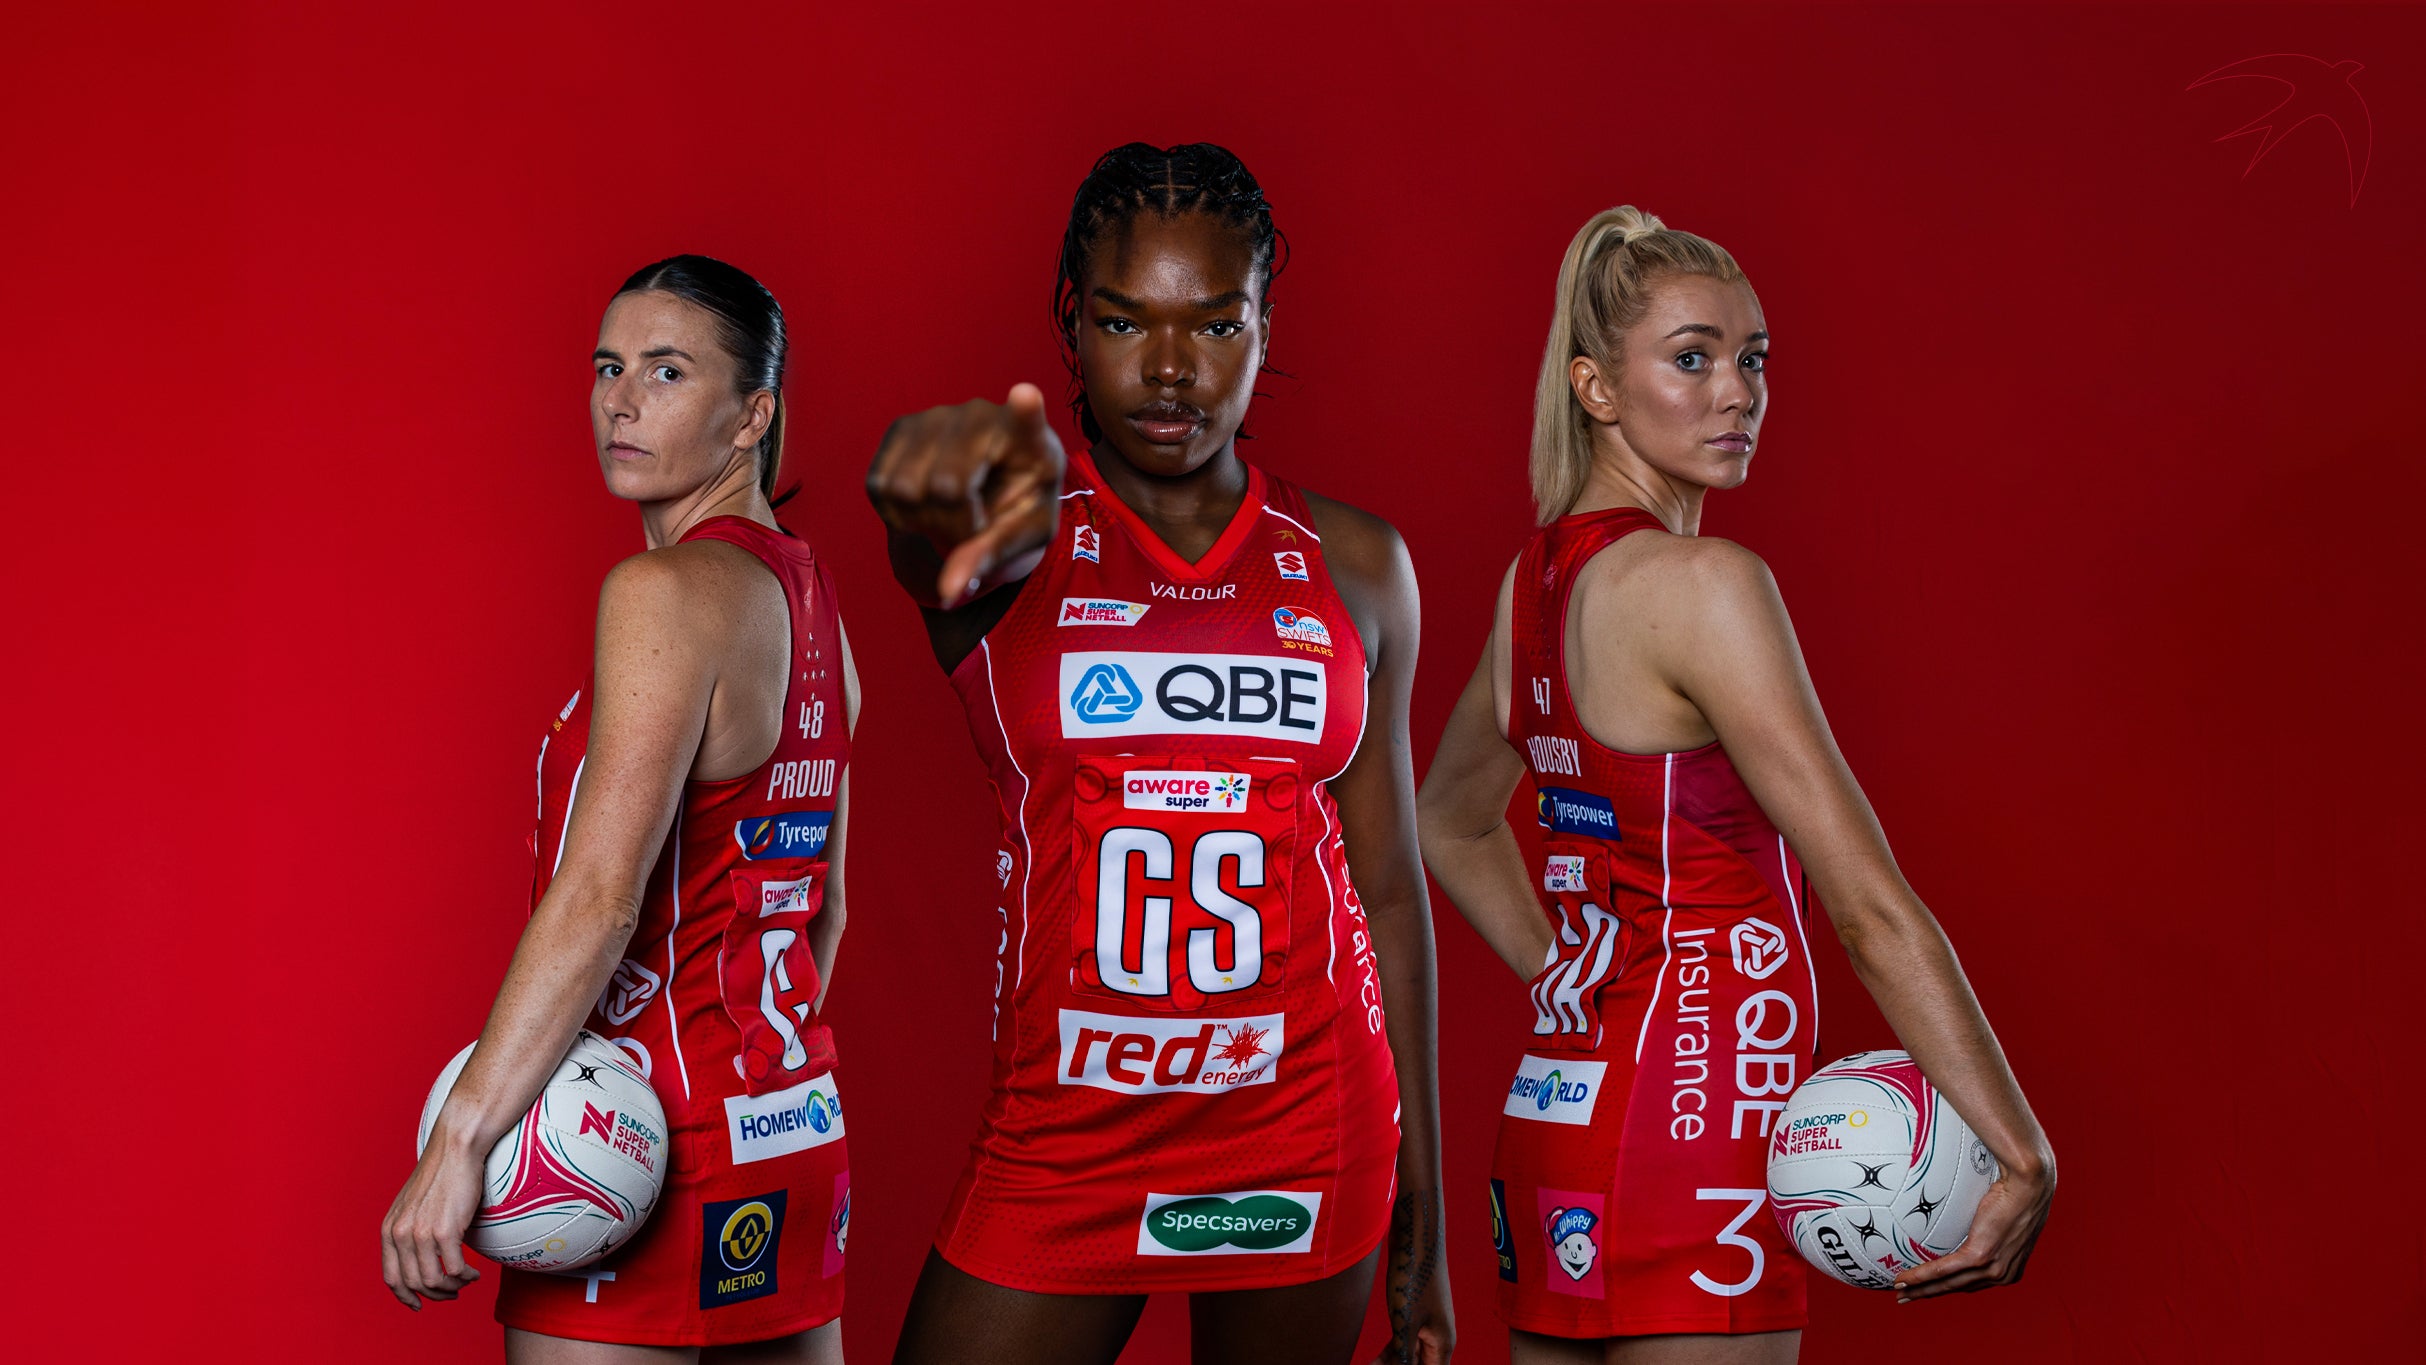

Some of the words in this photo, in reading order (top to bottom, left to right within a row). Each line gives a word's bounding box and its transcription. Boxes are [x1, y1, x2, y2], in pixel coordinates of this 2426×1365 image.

[1150, 582, 1236, 600] VALOUR
[1277, 627, 1332, 648] SWIFTS
[1297, 643, 1334, 658] YEARS
[1156, 664, 1318, 730] QBE
[1533, 677, 1550, 715] 47
[799, 701, 824, 739] 48
[767, 759, 835, 801] PROUD
[1127, 777, 1211, 796] aware
[1166, 795, 1209, 810] super
[1553, 796, 1614, 827] Tyrepower
[779, 822, 829, 849] Tyrepo
[1095, 826, 1266, 996] GS
[1670, 928, 1716, 1141] Insurance
[1068, 1023, 1215, 1086] red
[1730, 990, 1798, 1140] QBE
[1202, 1064, 1268, 1086] energy
[1510, 1069, 1588, 1111] OMEWORLD
[618, 1112, 661, 1146] SUNCORP
[1791, 1127, 1827, 1143] SUPER
[1792, 1113, 1846, 1131] SUNCORP
[616, 1125, 650, 1153] SUPER
[1790, 1138, 1842, 1155] NETBALL
[613, 1139, 654, 1173] NETBALL
[1162, 1210, 1297, 1231] Specsavers
[1559, 1214, 1591, 1235] Whippy
[1689, 1188, 1766, 1296] 3
[717, 1271, 766, 1294] METRO
